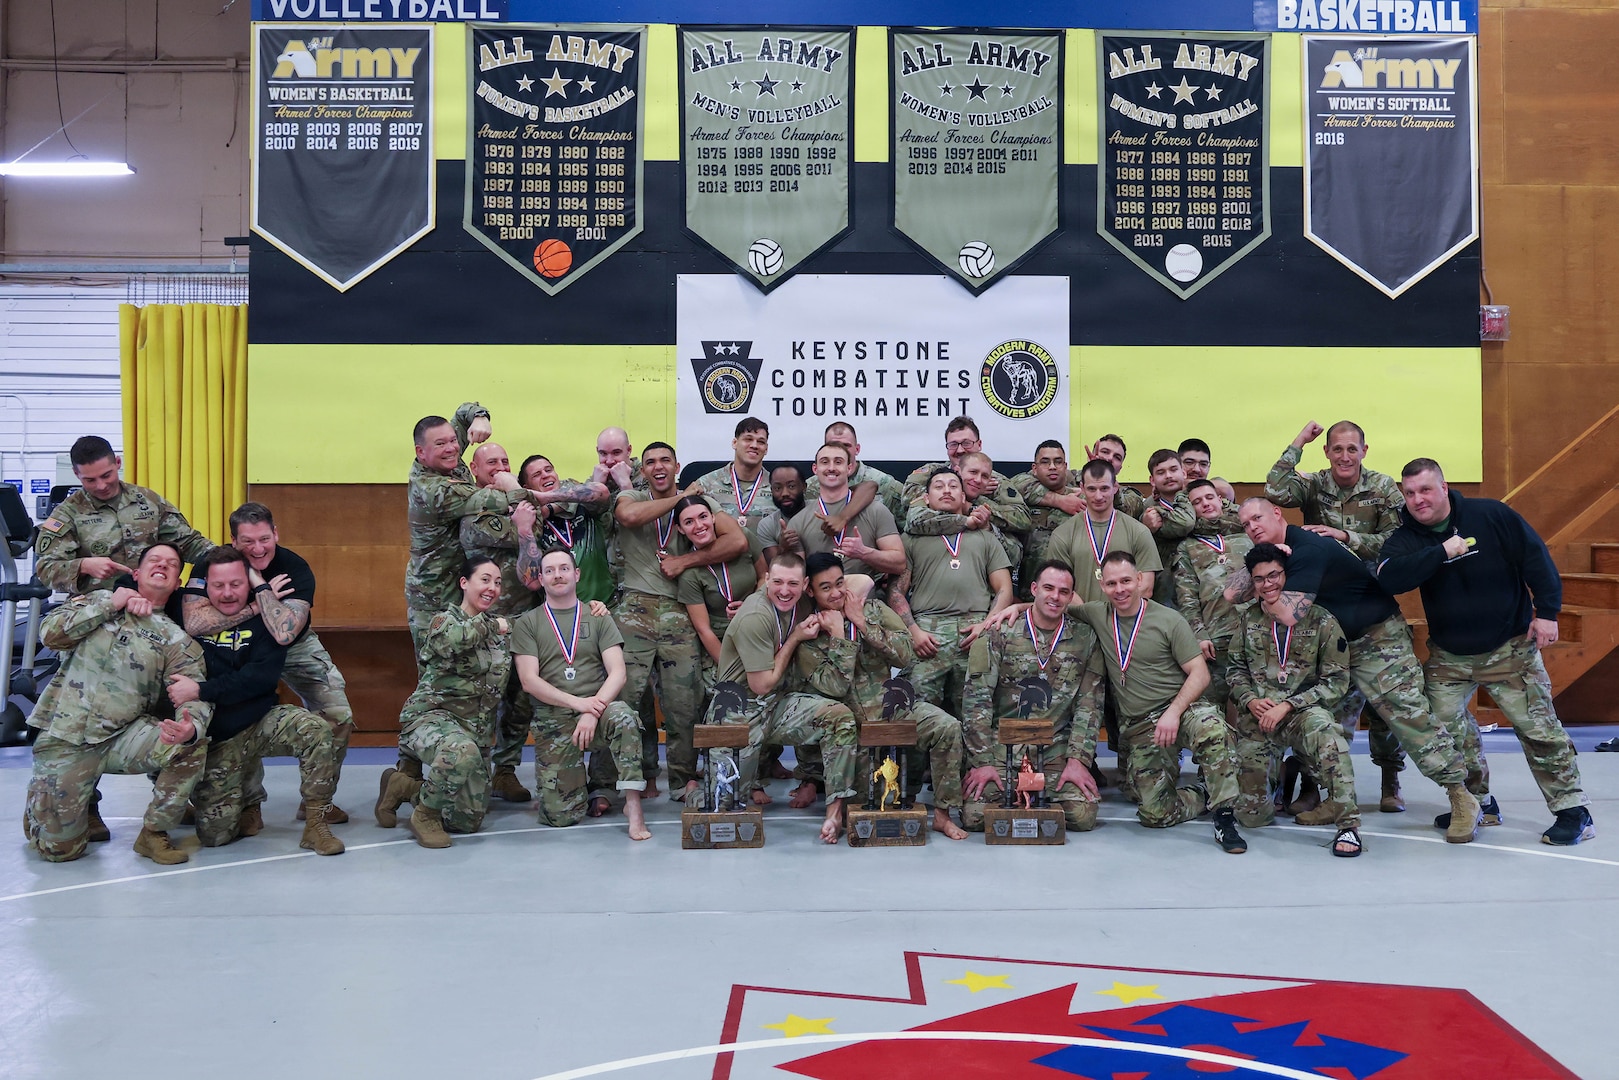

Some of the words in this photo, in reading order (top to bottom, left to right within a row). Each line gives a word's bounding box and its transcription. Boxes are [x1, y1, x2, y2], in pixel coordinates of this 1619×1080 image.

[269, 0, 500, 19] VOLLEYBALL
[1277, 0, 1466, 32] BASKETBALL
[479, 37, 534, 72] ALL
[546, 34, 634, 73] ARMY
[691, 39, 743, 74] ALL
[756, 37, 843, 74] ARMY
[901, 42, 953, 77] ALL
[966, 41, 1051, 78] ARMY
[1109, 44, 1162, 79] ALL
[1173, 43, 1259, 81] ARMY
[269, 87, 327, 100] WOMEN'S
[330, 88, 413, 100] BASKETBALL
[476, 80, 539, 120] WOMEN'S
[545, 85, 635, 123] BASKETBALL
[691, 91, 740, 121] MEN'S
[748, 93, 842, 124] VOLLEYBALL
[899, 91, 961, 126] WOMEN'S
[967, 95, 1053, 127] VOLLEYBALL
[1328, 97, 1384, 110] WOMEN'S
[1388, 98, 1450, 111] SOFTBALL
[275, 105, 311, 118] Armed
[314, 105, 352, 118] Forces
[356, 105, 413, 121] Champions
[1109, 93, 1176, 130] WOMEN'S
[1184, 98, 1258, 130] SOFTBALL
[266, 123, 299, 135] 2002
[307, 123, 340, 135] 2003
[348, 123, 381, 135] 2006
[389, 123, 423, 135] 2007
[1324, 115, 1359, 127] Armed
[1361, 114, 1398, 128] Forces
[1401, 116, 1455, 131] Champions
[478, 123, 518, 139] Armed
[522, 124, 564, 139] Forces
[569, 126, 633, 144] Champions
[690, 127, 731, 141] Armed
[735, 126, 775, 141] Forces
[782, 127, 845, 145] Champions
[900, 129, 940, 143] Armed
[944, 129, 984, 143] Forces
[990, 130, 1052, 148] Champions
[1108, 130, 1148, 145] Armed
[1152, 131, 1192, 146] Forces
[1198, 132, 1259, 151] Champions
[1315, 132, 1345, 145] 2016
[266, 138, 296, 149] 2010
[307, 138, 337, 149] 2014
[348, 138, 378, 150] 2016
[389, 138, 419, 150] 2019
[484, 145, 514, 158] 1978
[521, 146, 551, 158] 1979
[559, 146, 588, 159] 1980
[596, 147, 624, 159] 1982
[697, 147, 727, 159] 1975
[734, 147, 763, 159] 1988
[770, 147, 799, 159] 1990
[807, 148, 836, 159] 1992
[908, 147, 937, 159] 1996
[945, 148, 974, 160] 1997
[1011, 149, 1038, 161] 2011
[1116, 150, 1144, 163] 1977
[1151, 152, 1180, 164] 1984
[1187, 153, 1216, 165] 1986
[1222, 153, 1251, 165] 1987
[484, 162, 514, 175] 1983
[521, 163, 551, 175] 1984
[558, 163, 588, 176] 1985
[595, 164, 624, 176] 1986
[697, 164, 727, 176] 1994
[734, 164, 763, 176] 1995
[770, 164, 801, 176] 2006
[806, 163, 832, 175] 2011
[908, 162, 937, 175] 2013
[944, 162, 973, 174] 2014
[977, 162, 1006, 174] 2015
[1116, 168, 1144, 180] 1988
[1151, 169, 1180, 181] 1989
[1187, 169, 1216, 181] 1990
[1223, 170, 1249, 182] 1991
[484, 179, 513, 192] 1987
[521, 180, 551, 192] 1988
[558, 180, 588, 193] 1989
[595, 181, 624, 193] 1990
[698, 181, 727, 193] 2012
[734, 181, 763, 192] 2013
[770, 180, 798, 192] 2014
[1116, 184, 1144, 197] 1992
[1151, 185, 1180, 197] 1993
[1187, 186, 1216, 198] 1994
[1223, 186, 1251, 199] 1995
[483, 196, 513, 209] 1992
[520, 197, 550, 209] 1993
[558, 197, 587, 210] 1994
[595, 198, 624, 210] 1995
[1116, 201, 1145, 214] 1996
[1152, 202, 1181, 215] 1997
[1187, 202, 1216, 215] 1999
[1222, 202, 1251, 214] 2001
[484, 213, 514, 226] 1996
[520, 214, 550, 227] 1997
[557, 215, 587, 227] 1998
[595, 214, 624, 226] 1999
[1152, 218, 1183, 230] 2006
[1187, 218, 1216, 230] 2010
[1222, 218, 1251, 230] 2012
[500, 227, 534, 240] 2000
[576, 228, 606, 240] 2001
[1134, 234, 1163, 247] 2013
[1203, 234, 1232, 247] 2015
[792, 341, 950, 360] KEYSTONE
[986, 341, 1026, 366] MODERN
[1028, 343, 1054, 366] ARMY
[772, 369, 971, 388] COMBATIVES
[982, 376, 1025, 417] COMBATIVES
[1027, 376, 1057, 416] PROGRAM
[772, 398, 970, 416] TOURNAMENT
